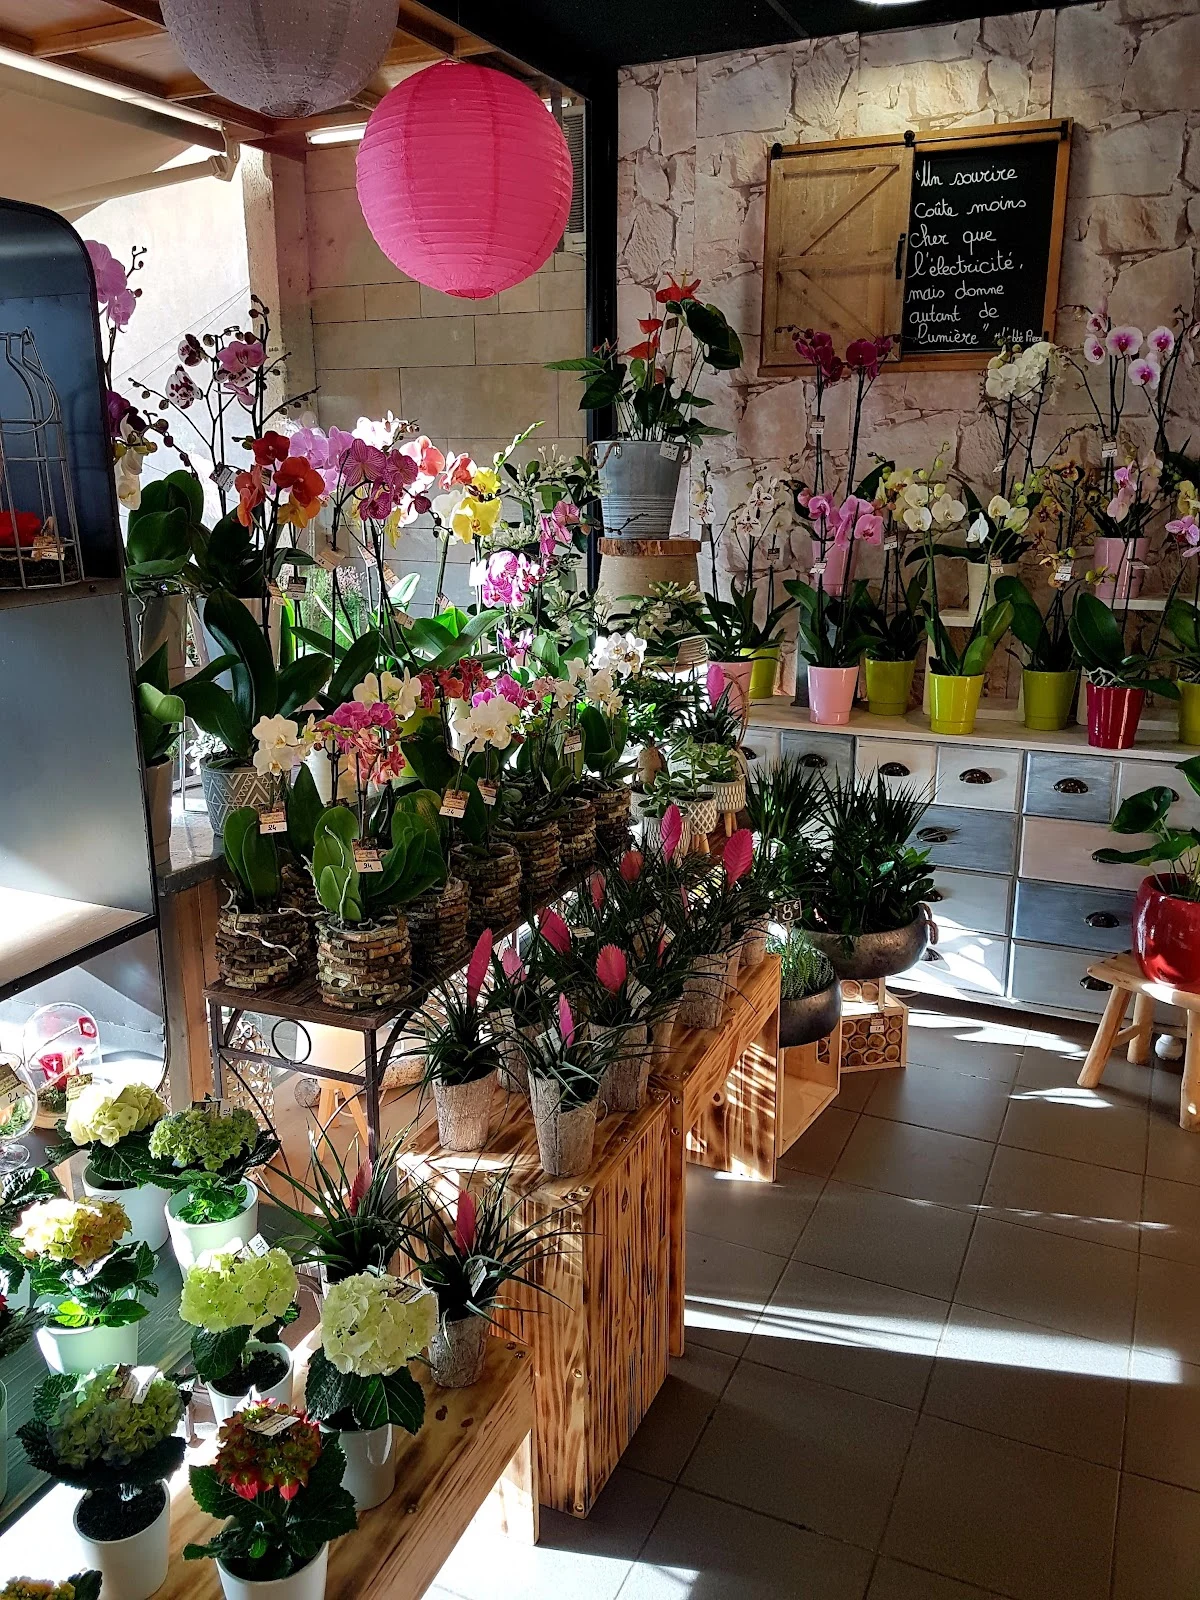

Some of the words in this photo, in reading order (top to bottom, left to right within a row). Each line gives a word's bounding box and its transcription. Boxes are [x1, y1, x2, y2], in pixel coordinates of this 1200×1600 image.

[949, 165, 1018, 186] sourire
[966, 196, 1027, 215] moins
[962, 230, 997, 255] que
[905, 285, 945, 304] mais
[954, 280, 1005, 300] donne
[909, 304, 961, 324] autant
[978, 301, 1000, 319] de
